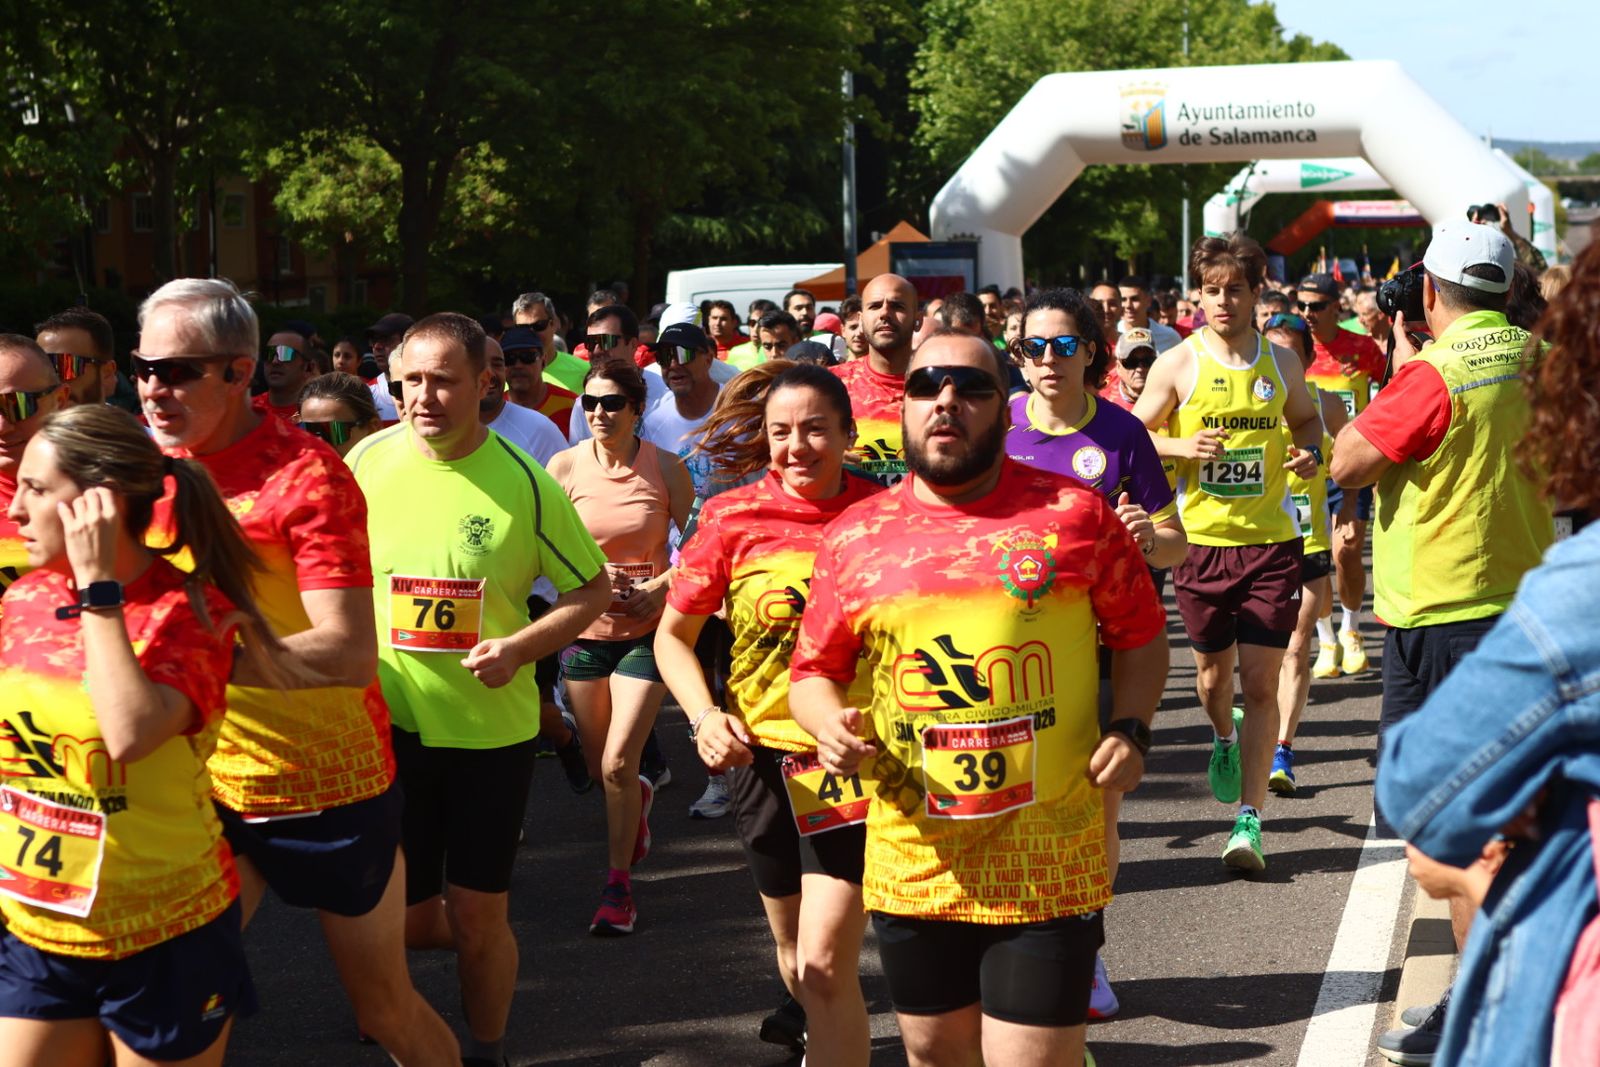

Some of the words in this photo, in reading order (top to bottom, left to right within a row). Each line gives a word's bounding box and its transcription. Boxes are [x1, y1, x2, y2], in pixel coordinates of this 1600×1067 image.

[1177, 100, 1315, 125] Ayuntamiento
[1179, 128, 1203, 146] de
[1209, 127, 1317, 146] Salamanca
[1202, 461, 1262, 484] 1294
[392, 578, 413, 593] XIV
[414, 586, 457, 597] CARRERA
[413, 598, 456, 631] 76
[895, 721, 916, 743] SAN
[1032, 706, 1056, 732] 026
[952, 736, 1006, 749] CARRERA
[953, 751, 1007, 792] 39
[817, 772, 865, 804] 41
[16, 825, 64, 877] 74
[994, 868, 1024, 883] VALOR
[1028, 867, 1048, 881] POR
